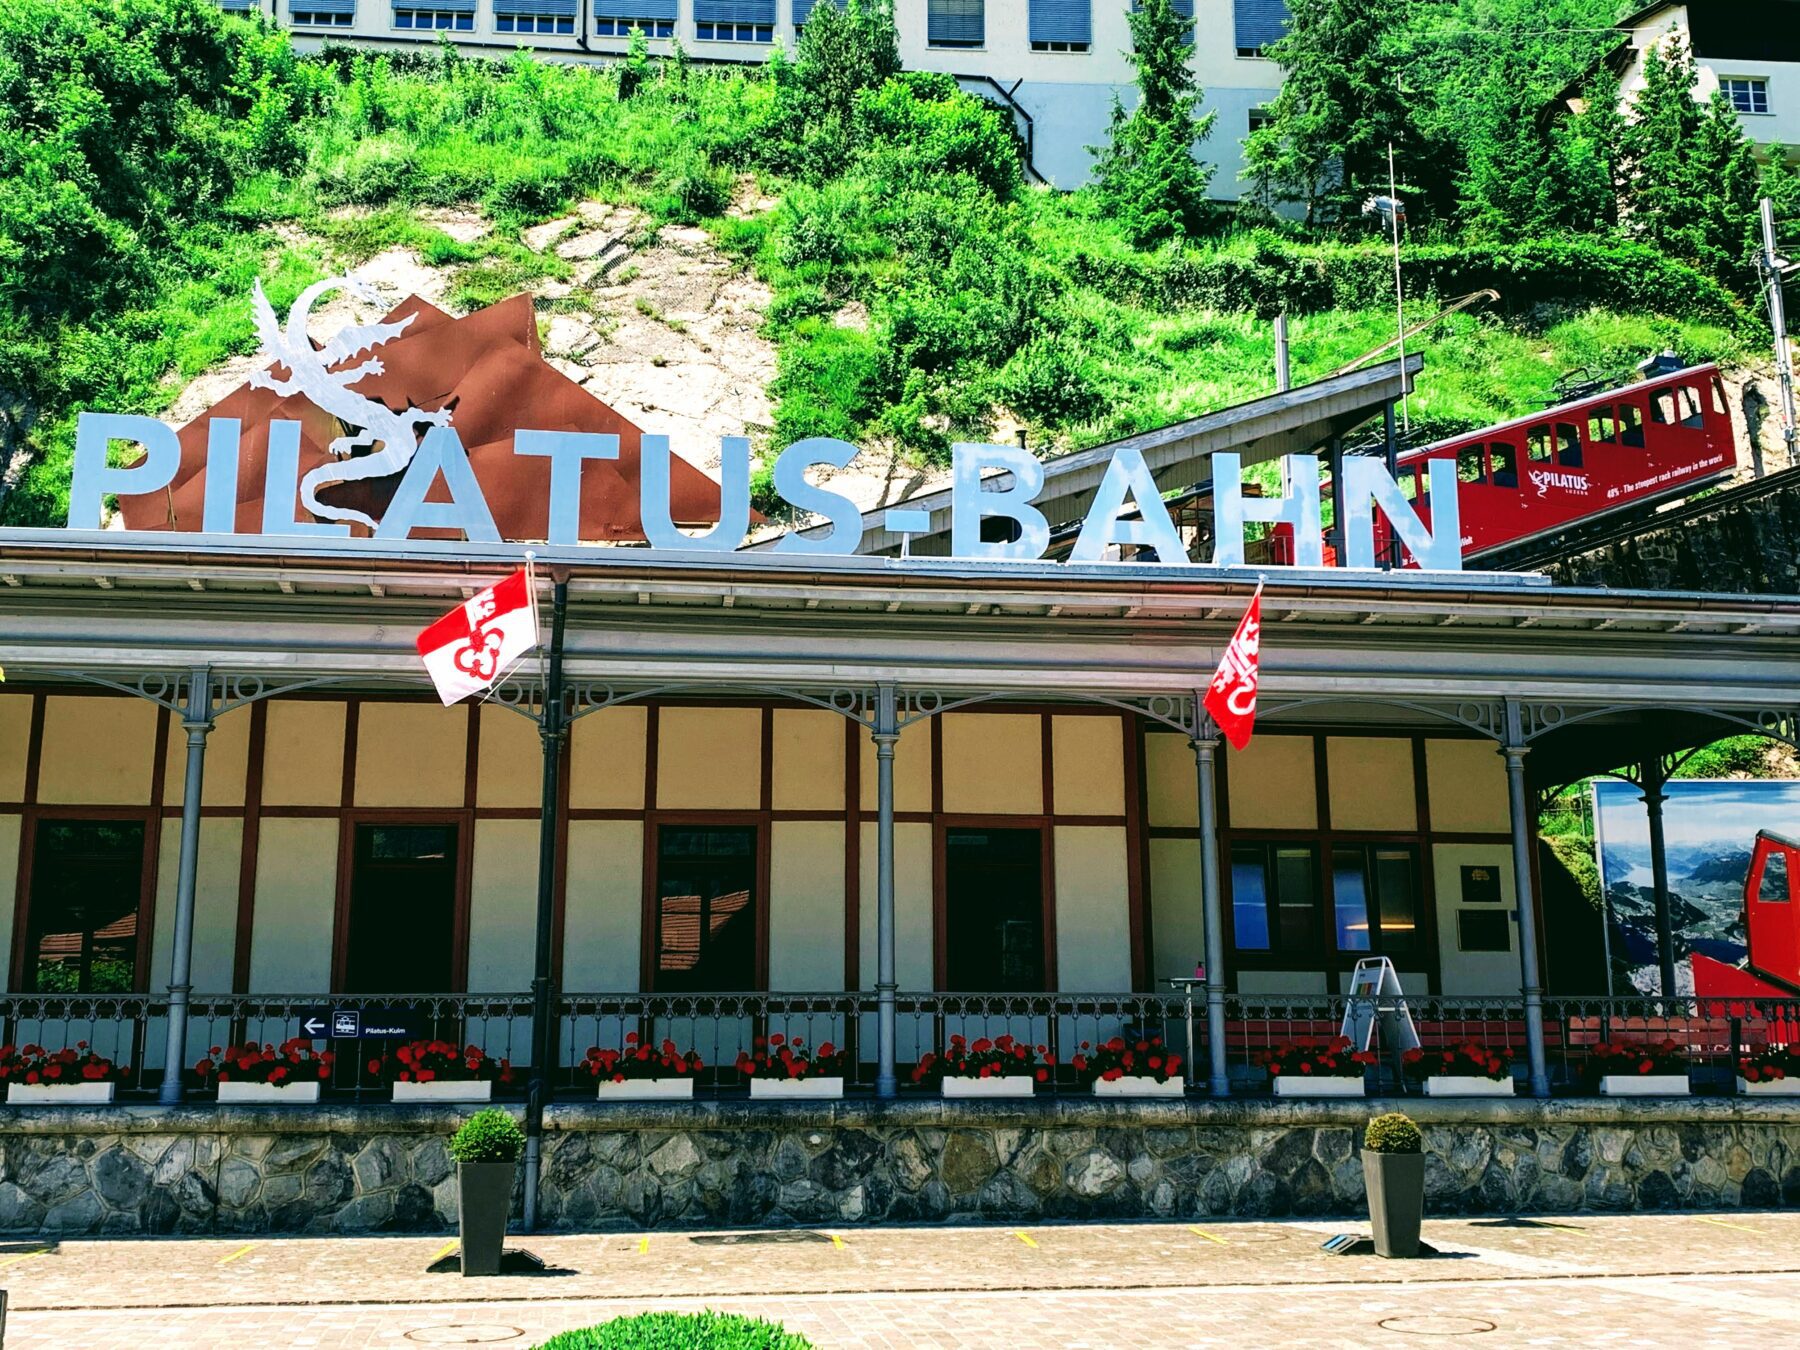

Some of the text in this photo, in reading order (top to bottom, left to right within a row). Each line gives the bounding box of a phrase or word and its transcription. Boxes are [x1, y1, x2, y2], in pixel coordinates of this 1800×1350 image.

[1543, 471, 1588, 490] PILATUS
[1623, 484, 1634, 493] The
[1635, 476, 1659, 489] steepest
[1659, 471, 1671, 481] rack
[1672, 466, 1692, 477] railway
[1693, 462, 1698, 470] in
[1699, 459, 1708, 468] the
[1709, 453, 1723, 465] world
